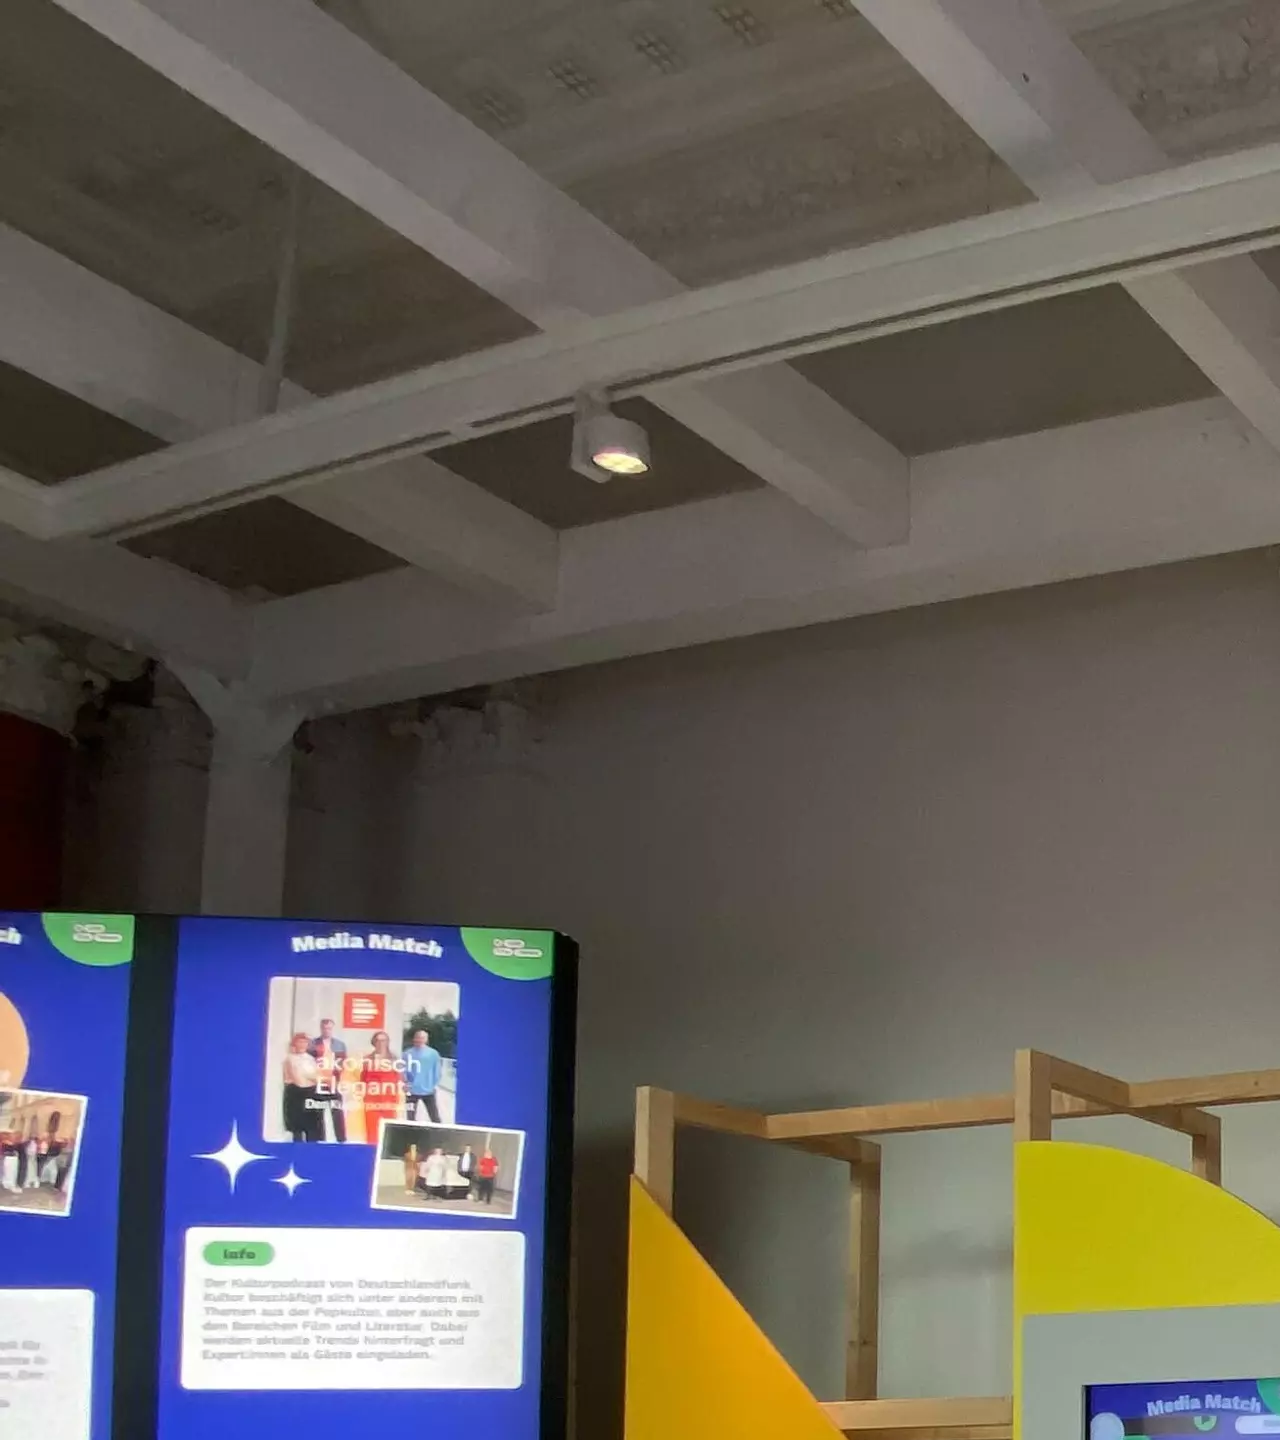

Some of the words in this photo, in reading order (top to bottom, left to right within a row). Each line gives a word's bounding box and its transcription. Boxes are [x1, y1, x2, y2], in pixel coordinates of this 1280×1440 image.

[291, 932, 364, 952] Media
[368, 933, 443, 958] Match
[1147, 1395, 1201, 1416] Media
[1205, 1394, 1261, 1414] Match
